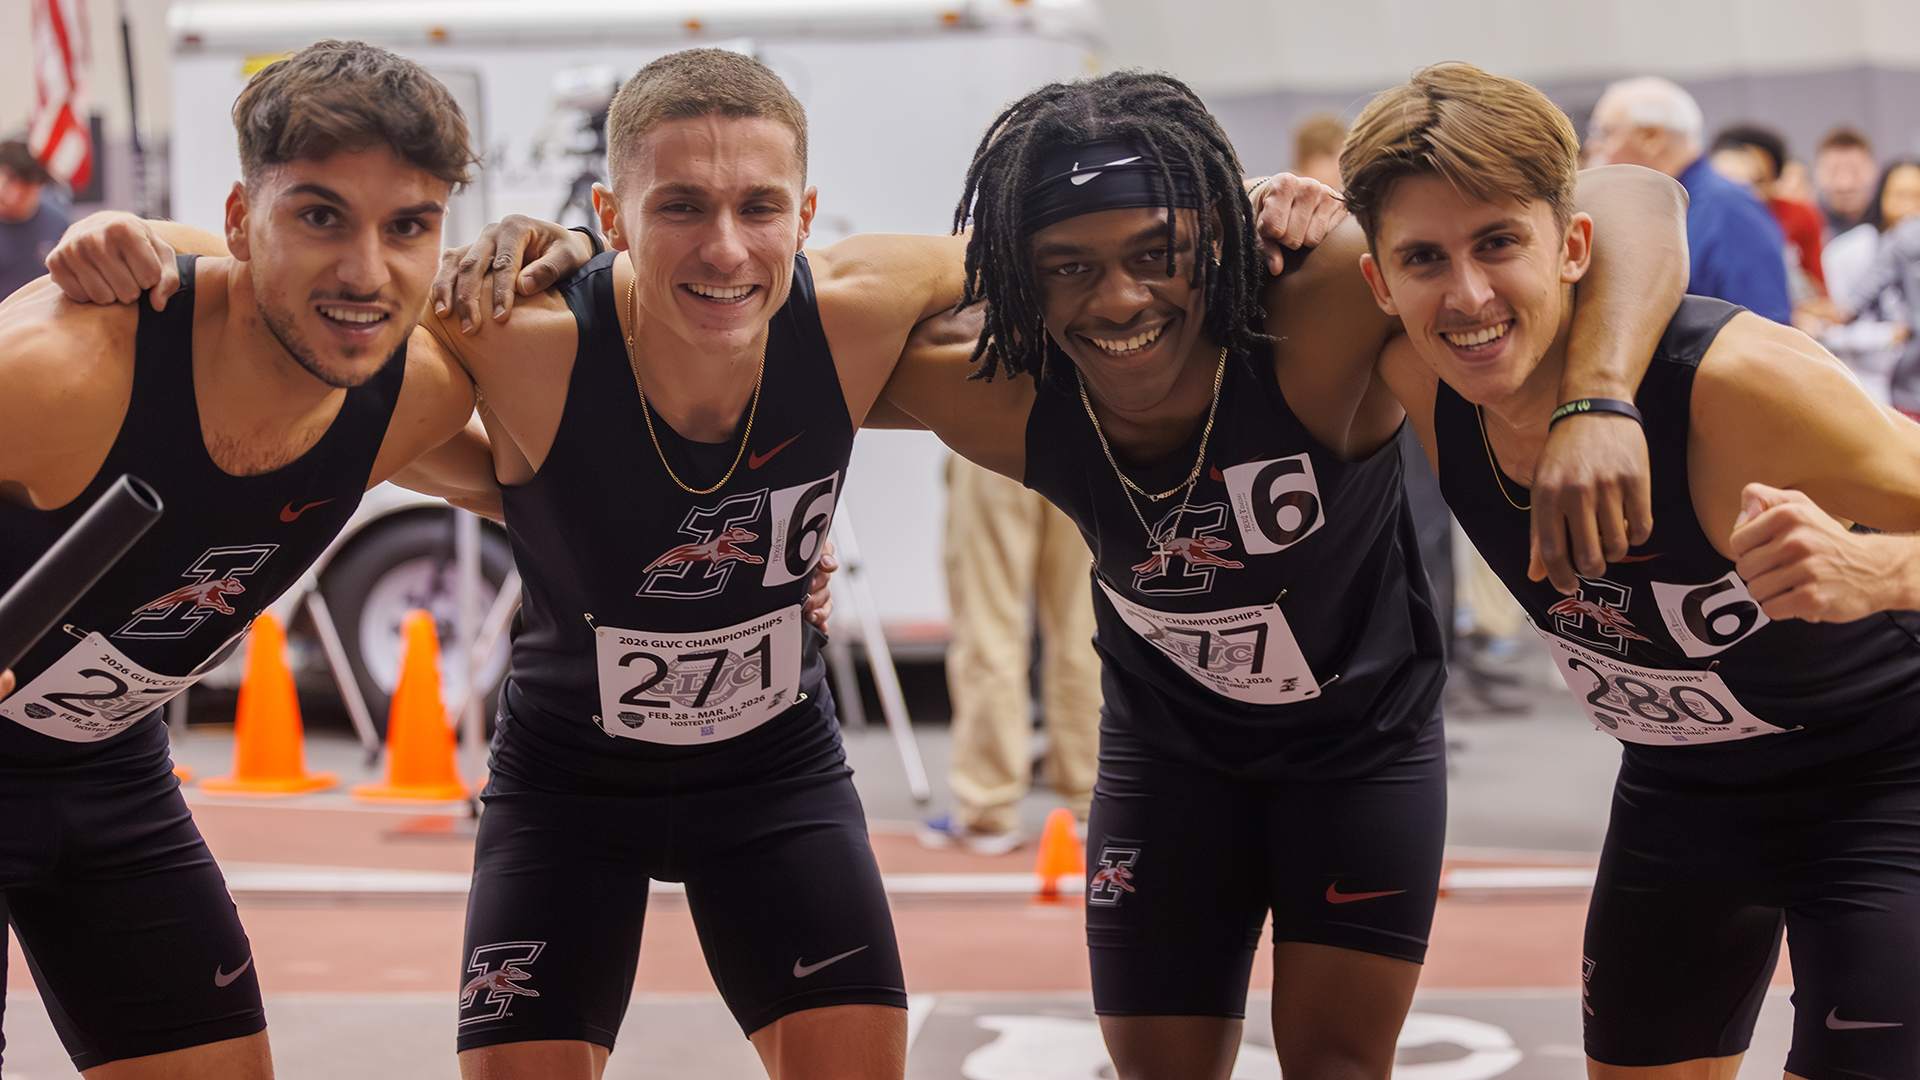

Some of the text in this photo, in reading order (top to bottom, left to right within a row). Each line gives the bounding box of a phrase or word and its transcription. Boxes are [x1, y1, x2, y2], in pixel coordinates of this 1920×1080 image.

[1251, 459, 1319, 545] 6
[785, 477, 834, 577] 6
[1165, 610, 1262, 627] CHAMPIONSHIPS
[1682, 579, 1758, 647] 6
[619, 616, 783, 649] 2026 GLVC CHAMPIONSHIPS
[99, 653, 163, 686] 2026 GLVC
[618, 633, 771, 709] 271
[1245, 676, 1272, 685] 2026
[1582, 652, 1609, 669] GLVC
[1608, 663, 1703, 682] CHAMPIONSHIPS
[1568, 657, 1734, 726] 280
[59, 712, 82, 724] FEB.
[648, 711, 672, 720] FEB.
[697, 708, 727, 719] MAR.
[729, 705, 738, 713] 1,
[740, 694, 766, 709] 2026
[717, 711, 743, 722] UINDY
[1616, 716, 1639, 727] FEB.
[1641, 721, 1652, 729] 28
[1660, 724, 1690, 732] MAR.
[1640, 727, 1673, 736] HOSTED
